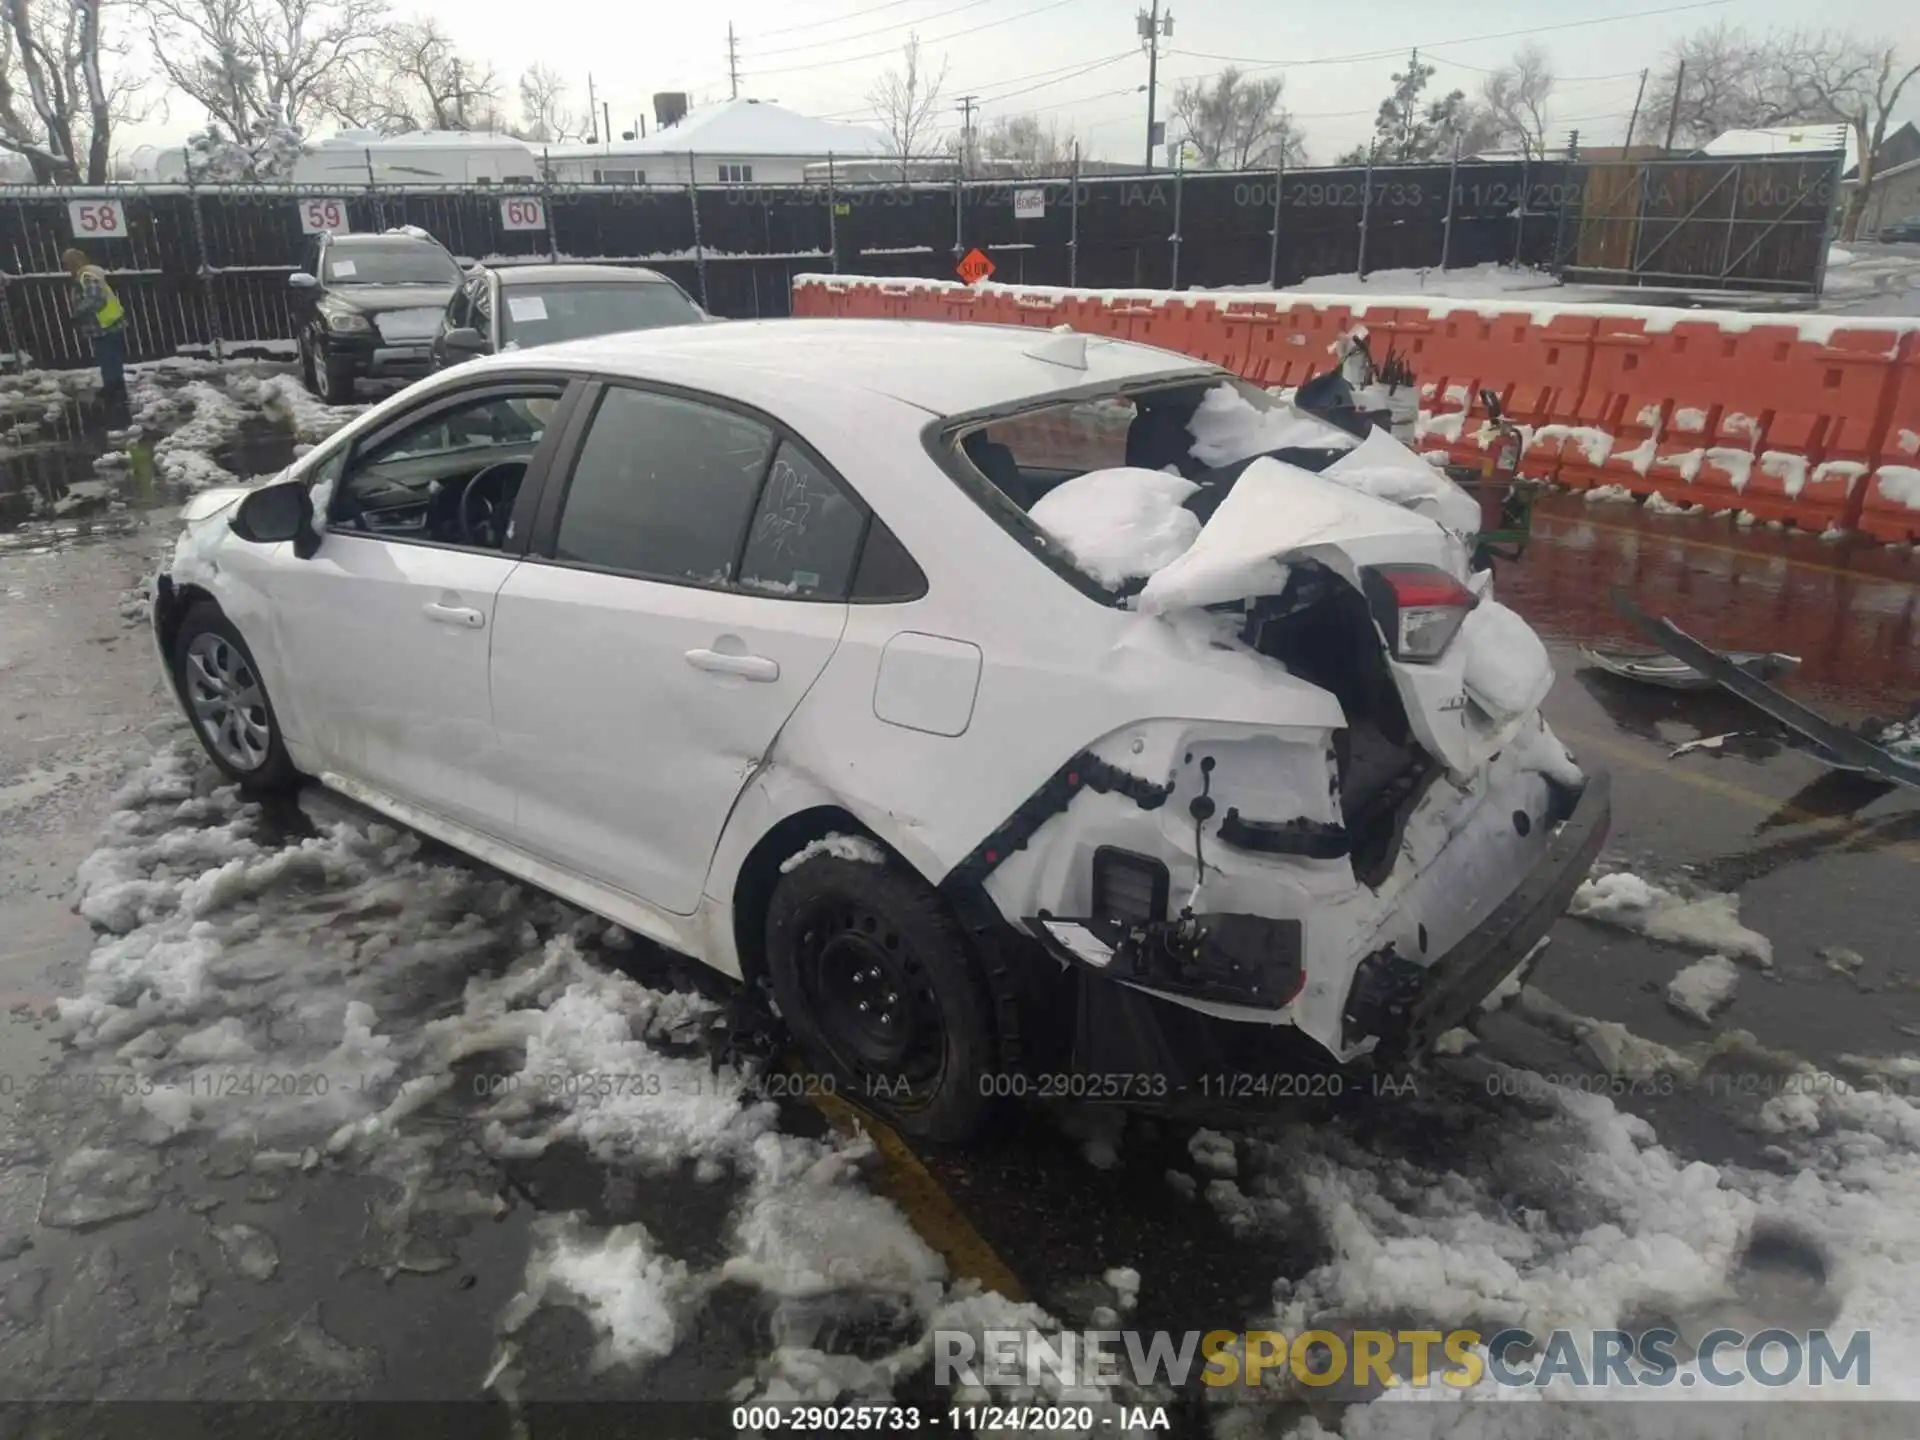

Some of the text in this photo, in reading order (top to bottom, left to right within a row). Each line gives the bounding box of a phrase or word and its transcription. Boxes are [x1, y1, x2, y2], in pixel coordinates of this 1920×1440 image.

[79, 206, 118, 231] 58
[309, 204, 340, 228] 59
[508, 201, 538, 225] 60
